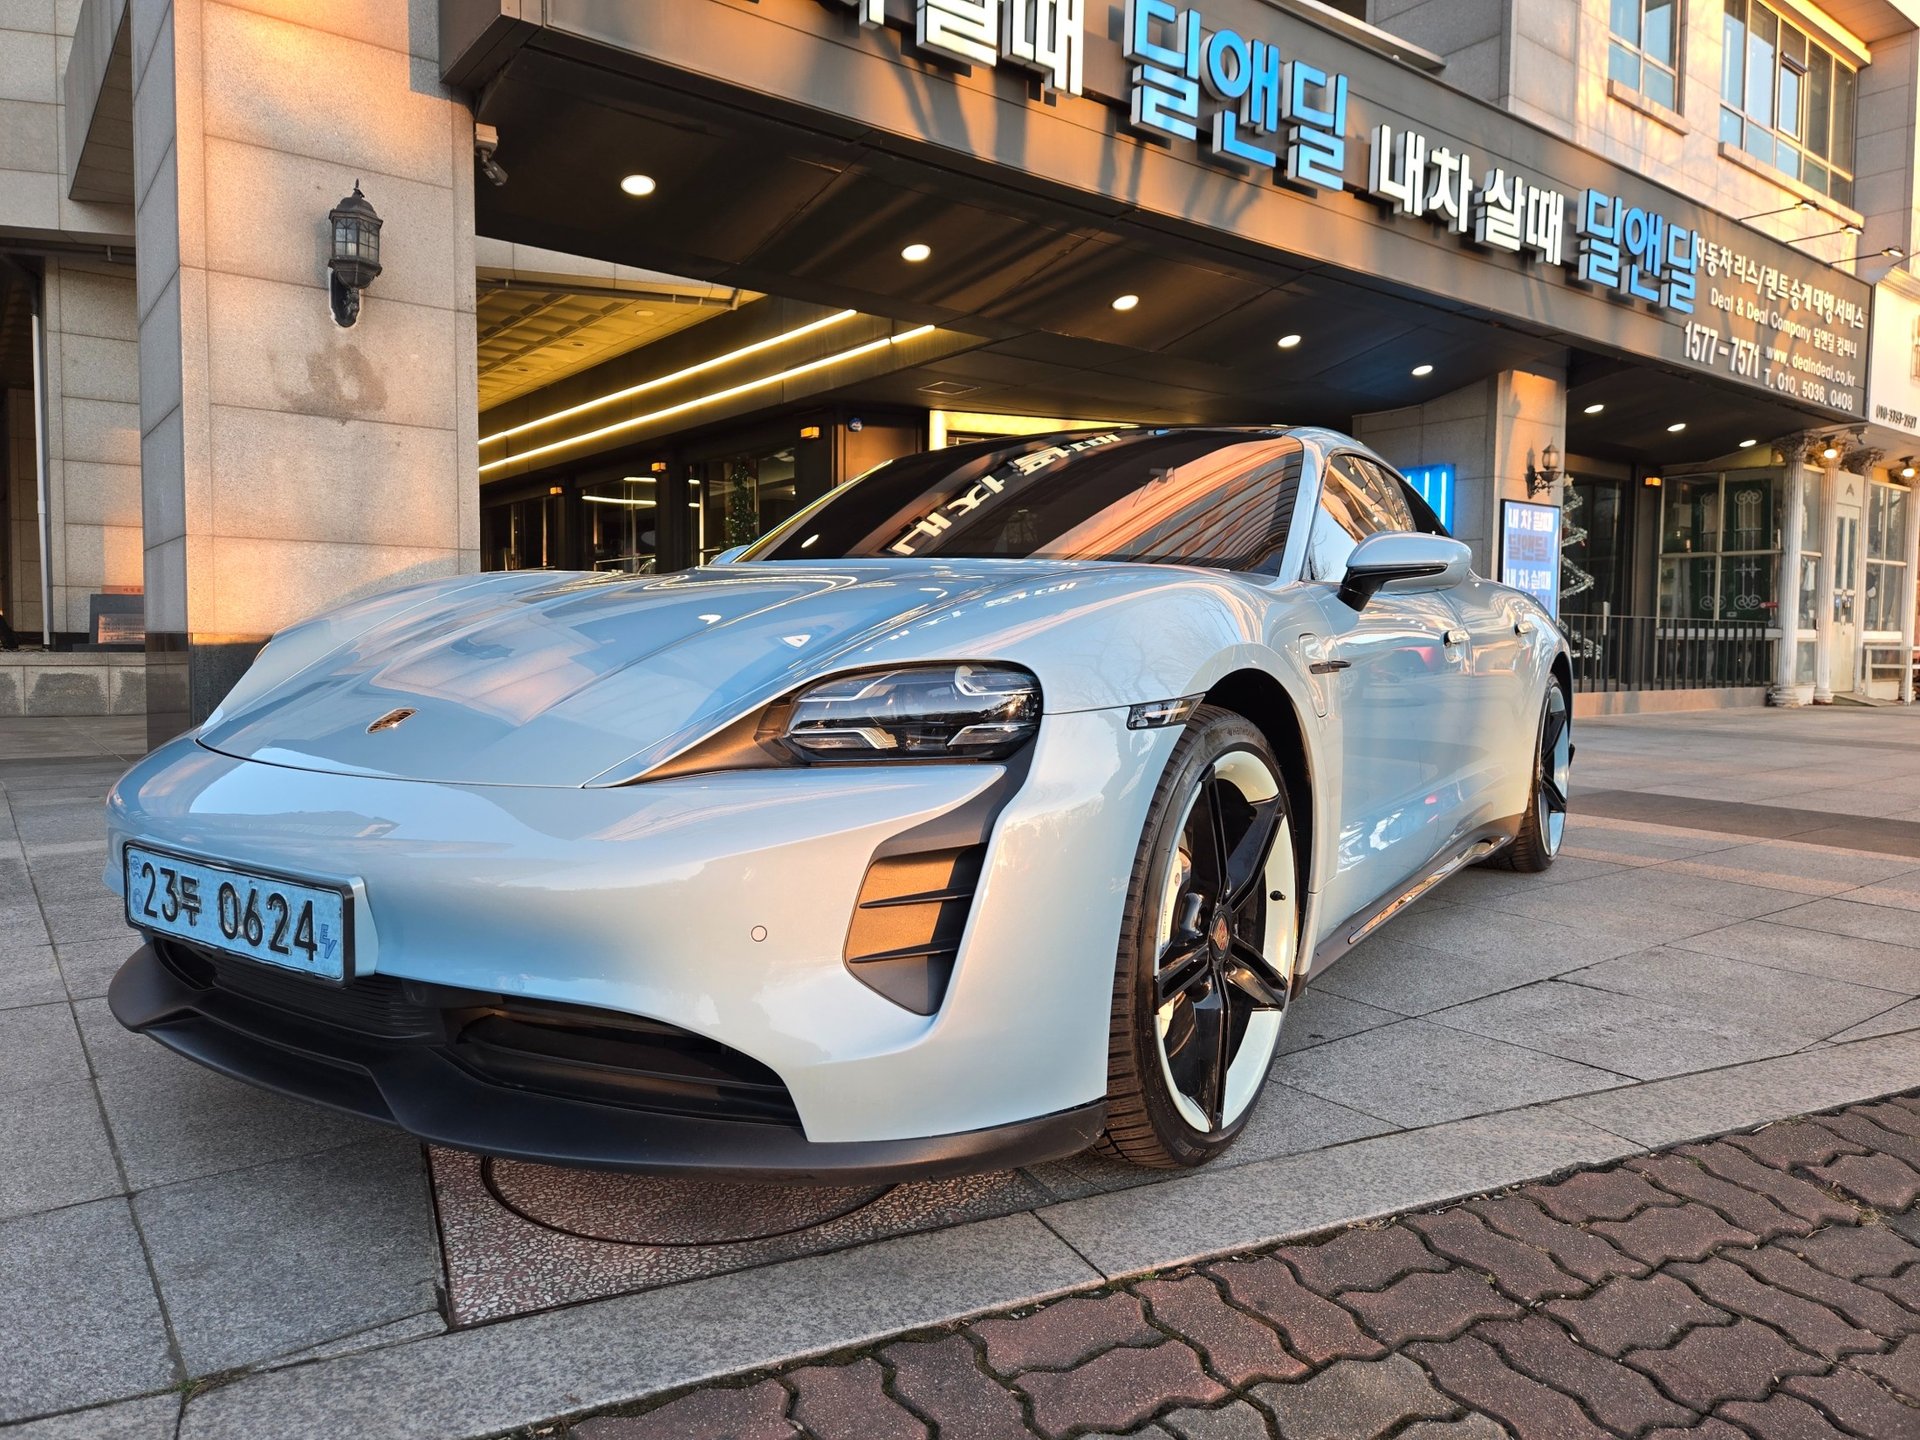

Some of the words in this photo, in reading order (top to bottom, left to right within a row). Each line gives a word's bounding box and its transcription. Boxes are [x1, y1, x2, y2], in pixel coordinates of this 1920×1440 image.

[1125, 0, 1348, 192] 딜앤딜
[1578, 188, 1698, 314] 딜앤딜
[1710, 287, 1734, 313] Deal
[1736, 297, 1745, 316] &
[1746, 301, 1769, 325] Deal
[1770, 312, 1811, 343] Company
[1813, 327, 1835, 353] 딜앤딜
[219, 881, 318, 961] 0624
